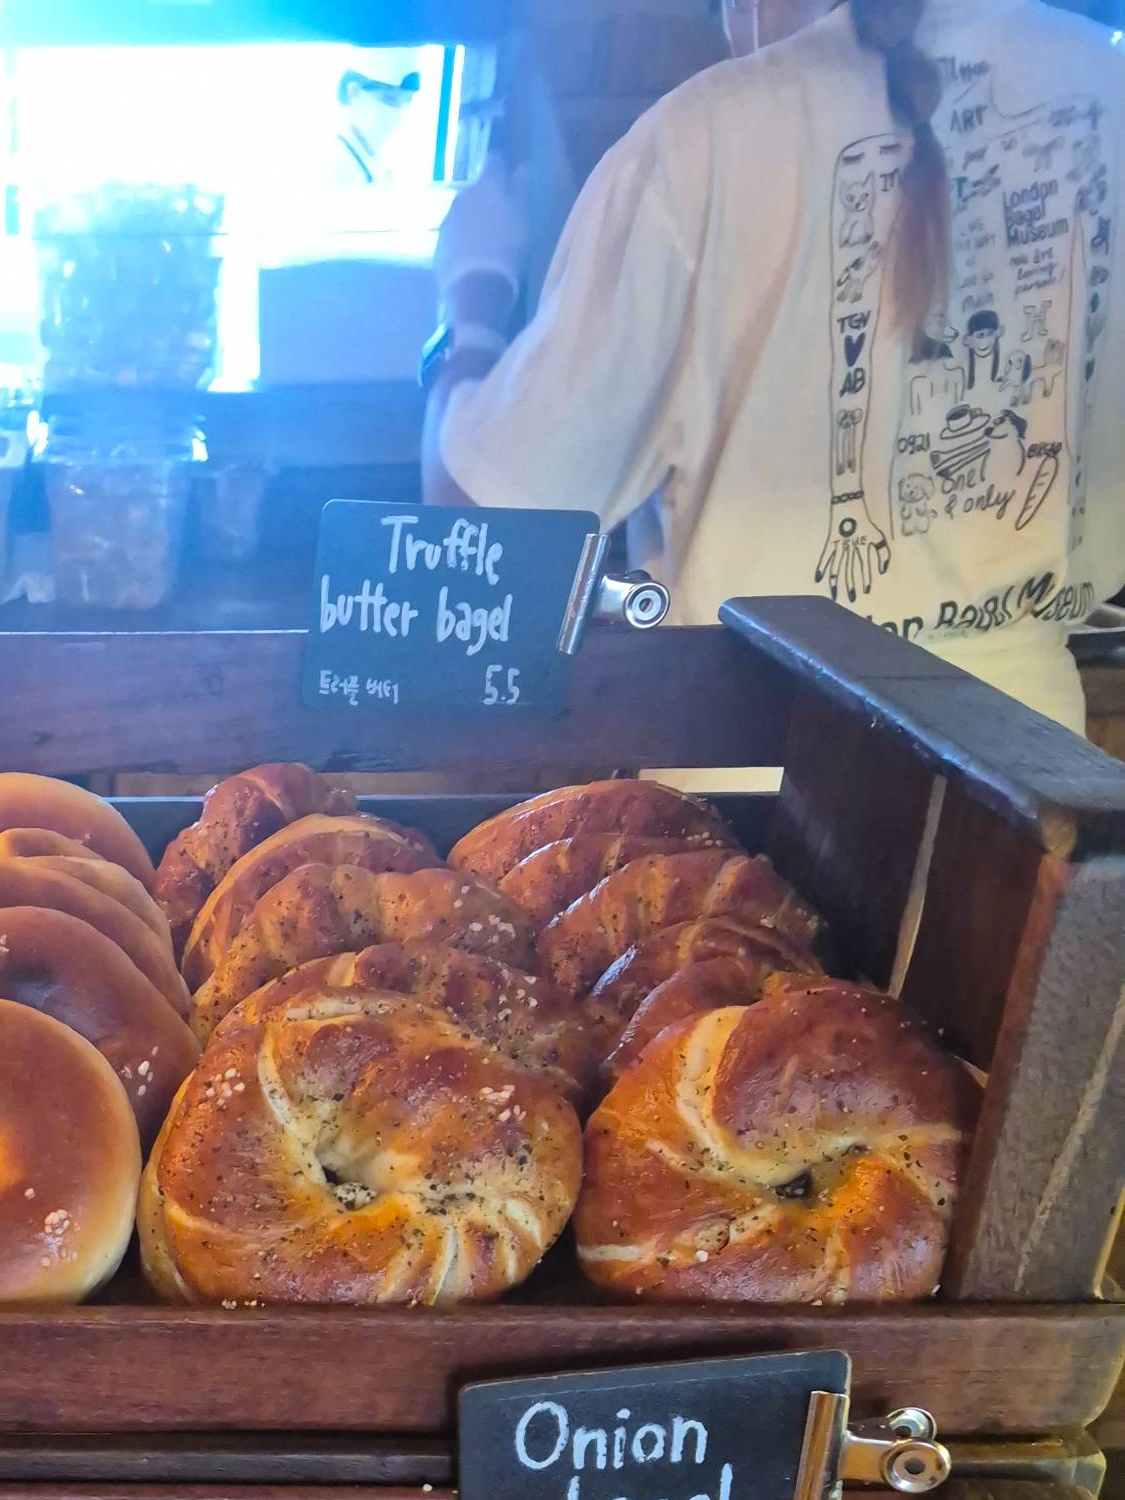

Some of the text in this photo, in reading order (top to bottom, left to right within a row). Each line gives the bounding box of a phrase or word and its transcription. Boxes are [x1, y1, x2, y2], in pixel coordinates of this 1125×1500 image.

[1003, 179, 1059, 208] London
[839, 367, 866, 398] AB
[963, 484, 1017, 520] only
[381, 515, 504, 586] Truffle
[320, 574, 514, 656] butter bagel
[318, 670, 399, 706] 트러플 버터
[482, 664, 521, 705] 5.5
[515, 1400, 708, 1470] Onion
